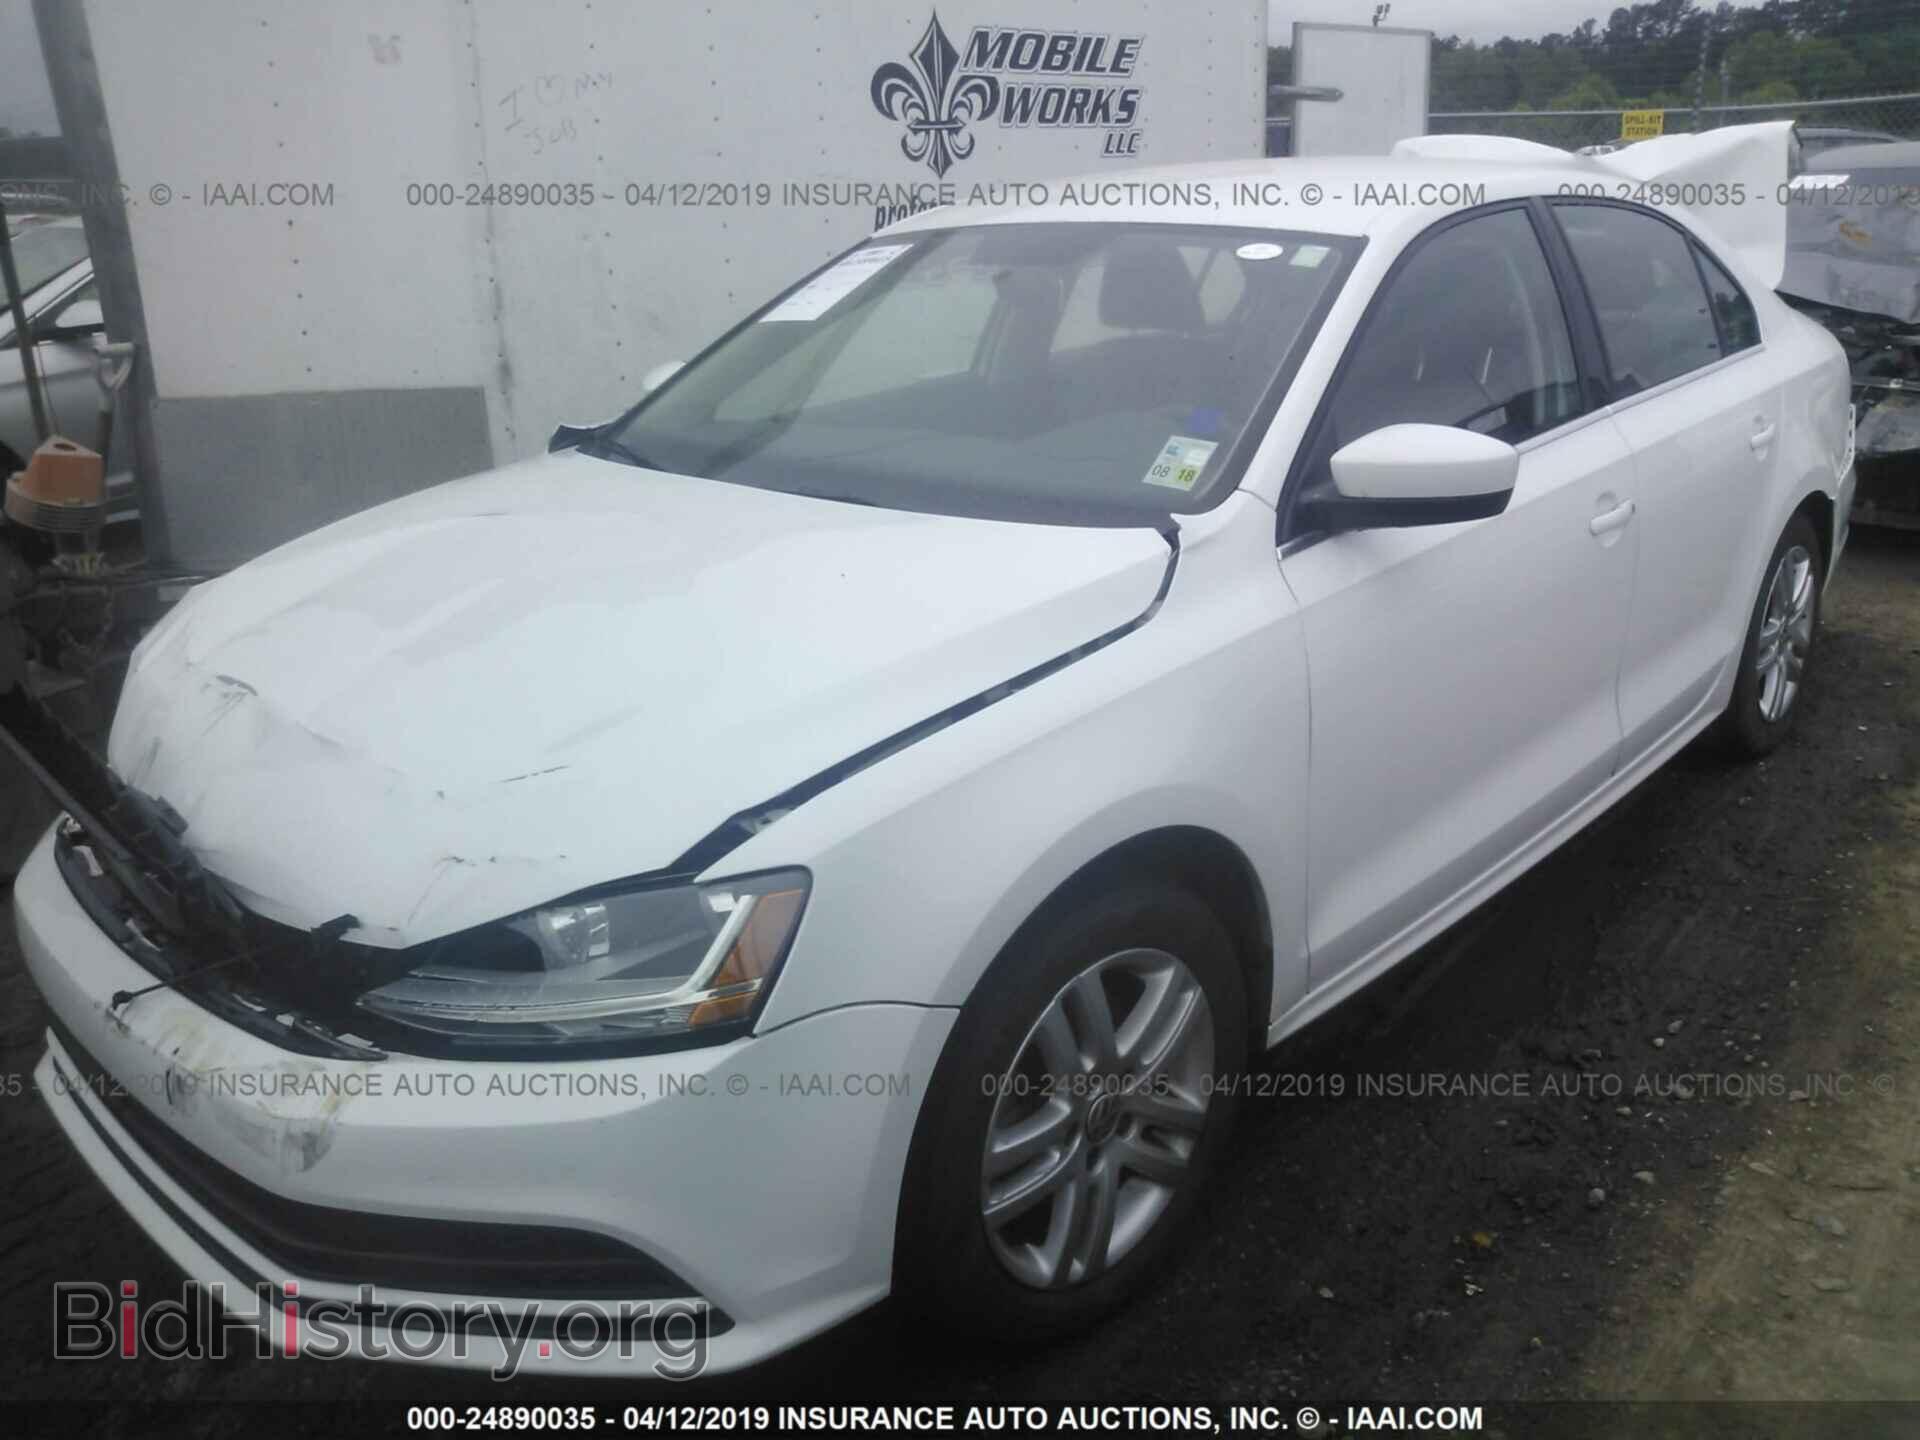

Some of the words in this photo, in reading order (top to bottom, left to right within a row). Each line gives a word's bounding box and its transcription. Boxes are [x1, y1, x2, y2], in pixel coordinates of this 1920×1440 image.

[962, 29, 1141, 75] MOBILE
[1002, 85, 1141, 125] WORKS
[1103, 132, 1140, 154] LLC
[1151, 464, 1171, 478] 08
[1178, 468, 1198, 482] 18
